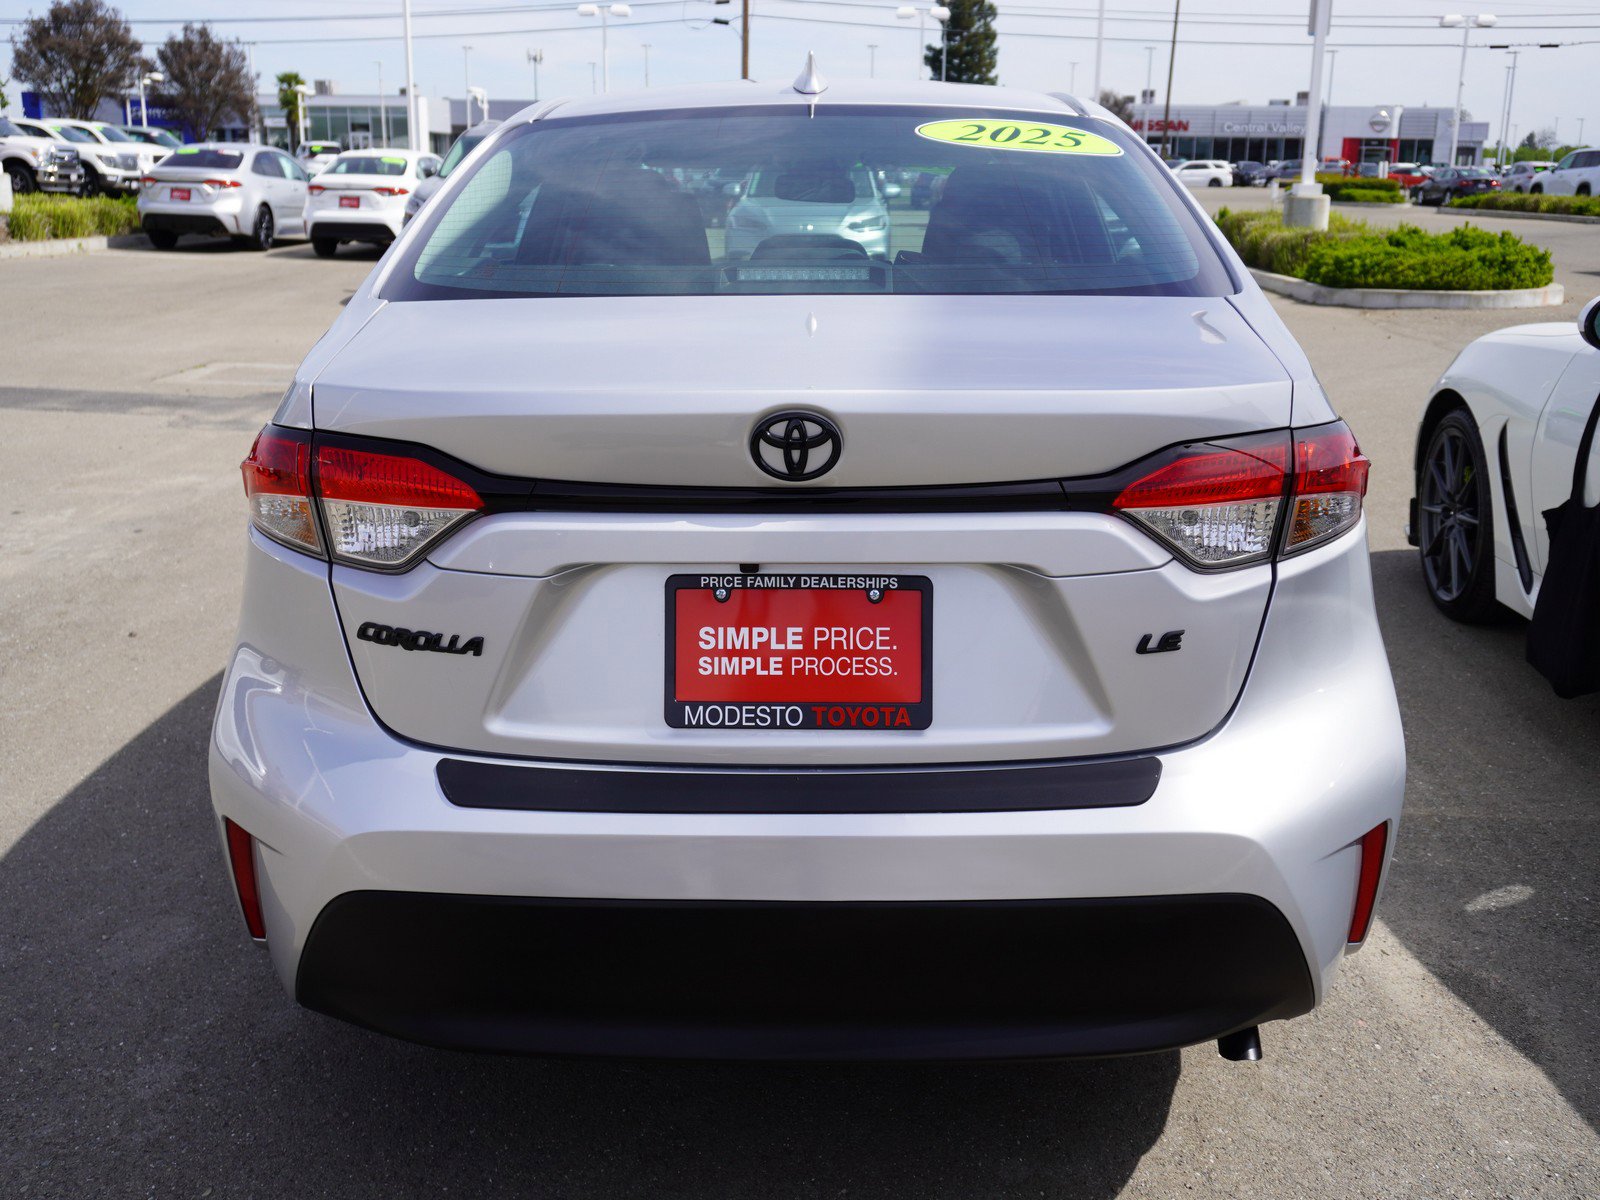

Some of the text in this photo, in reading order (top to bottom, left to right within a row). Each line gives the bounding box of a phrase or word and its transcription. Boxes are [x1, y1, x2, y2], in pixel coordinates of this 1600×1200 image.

[953, 124, 1086, 147] 2025
[1224, 121, 1306, 135] Central Valley
[700, 576, 898, 589] PRICE FAMILY DEALERSHIPS
[357, 621, 485, 656] COROLLA
[698, 626, 897, 650] SIMPLE PRICE.
[1135, 629, 1186, 655] LE
[698, 656, 898, 676] SIMPLE PROCESS.
[684, 705, 912, 727] MODESTO TOYOTA
